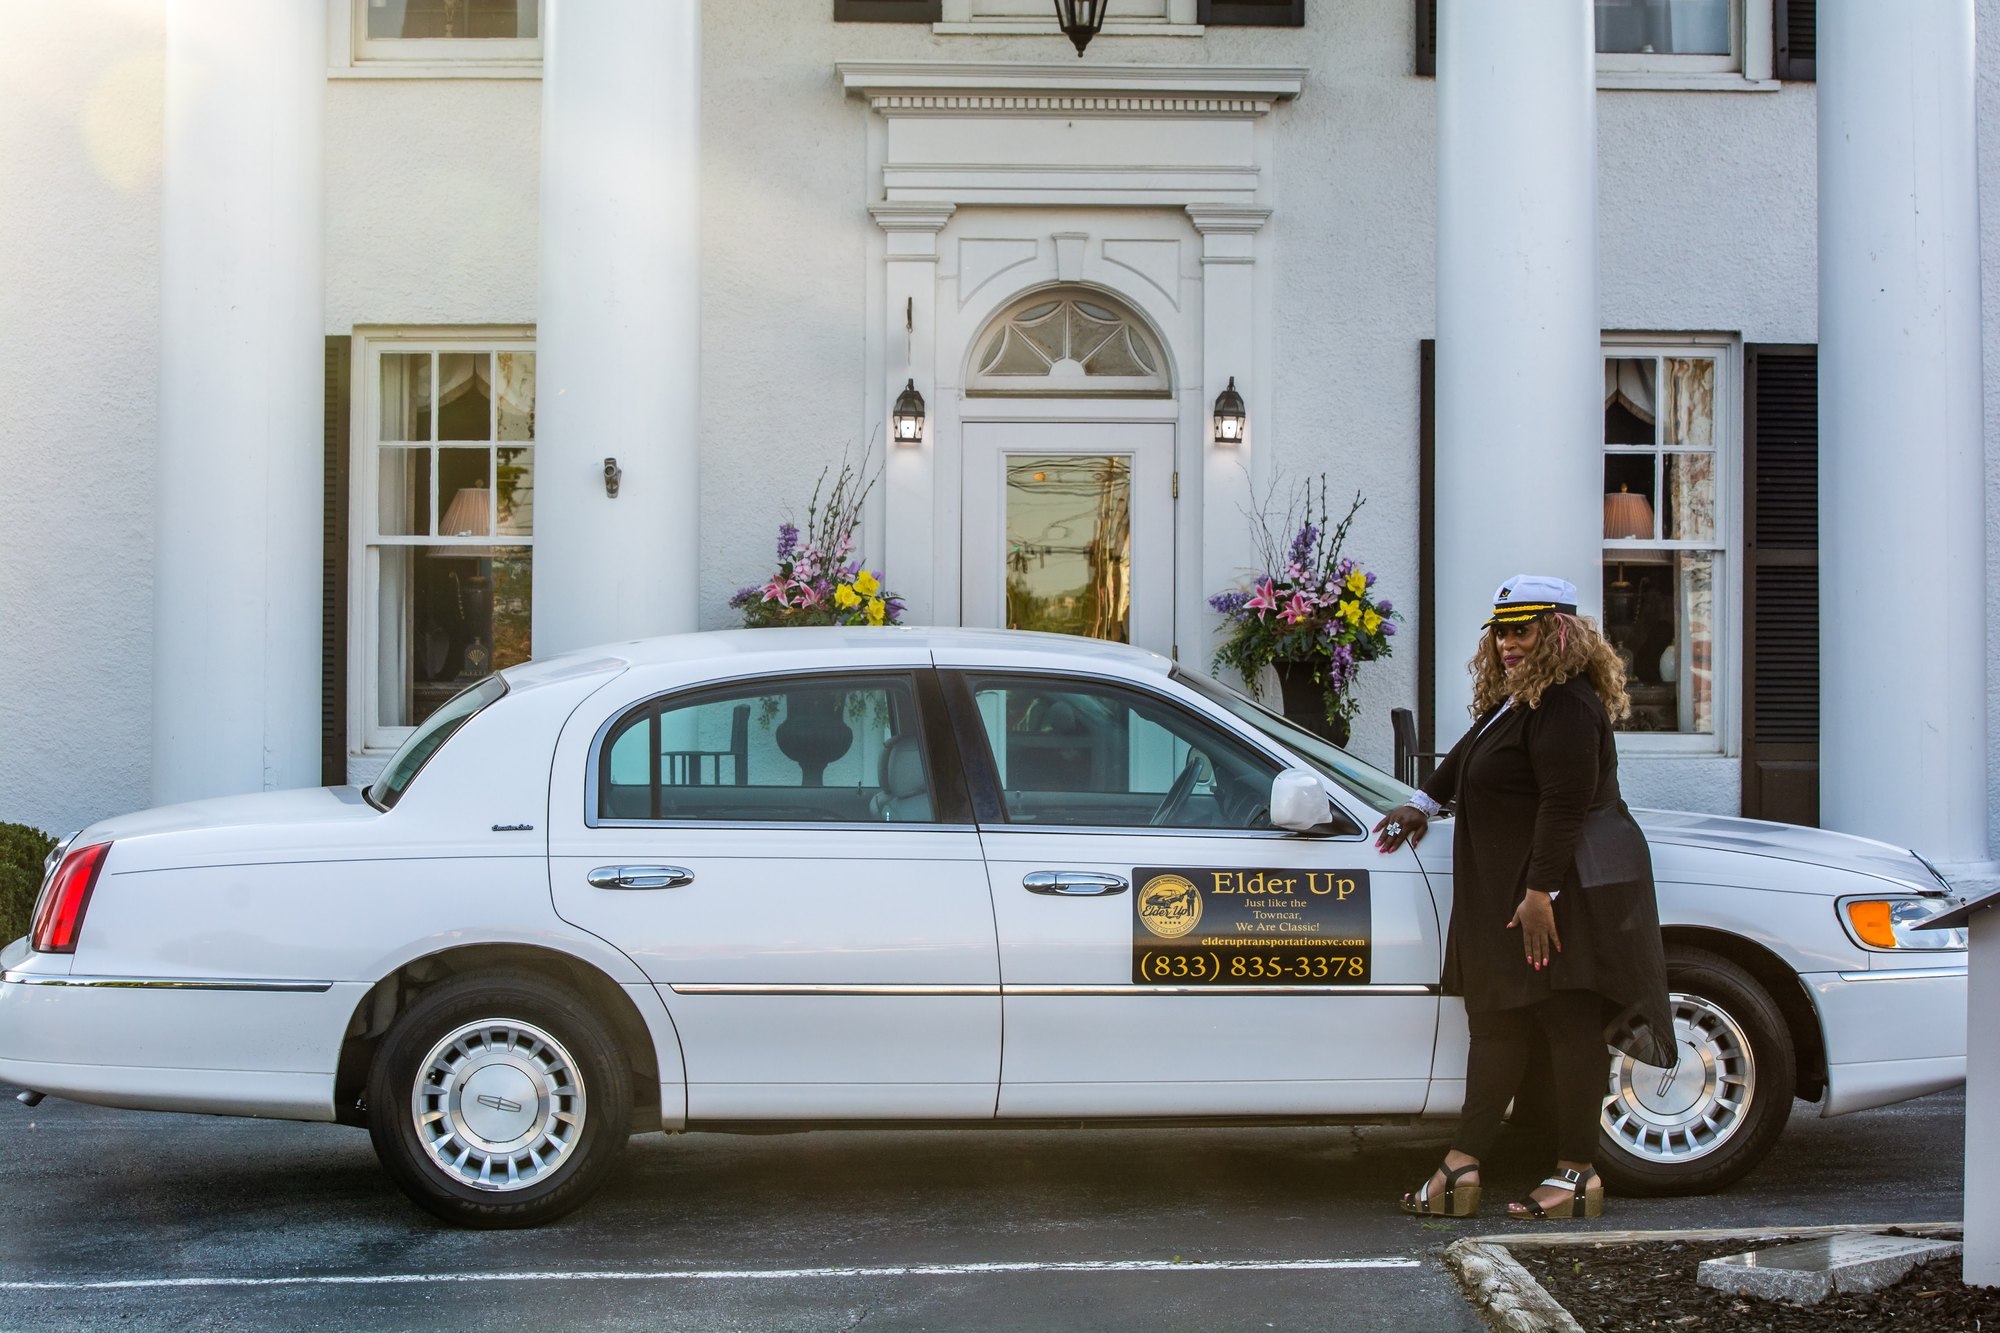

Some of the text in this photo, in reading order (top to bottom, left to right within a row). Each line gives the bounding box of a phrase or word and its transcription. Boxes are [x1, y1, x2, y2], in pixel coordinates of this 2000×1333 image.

[1210, 871, 1297, 894] Elder
[1305, 872, 1356, 901] Up
[1244, 898, 1308, 908] Just like the
[1141, 904, 1172, 918] Elder
[1252, 910, 1303, 920] Towncar,
[1235, 922, 1320, 932] We Are Classic!
[1201, 936, 1366, 948] elderuptransportationsvc.com
[1141, 951, 1364, 981] (833) 835-3378
